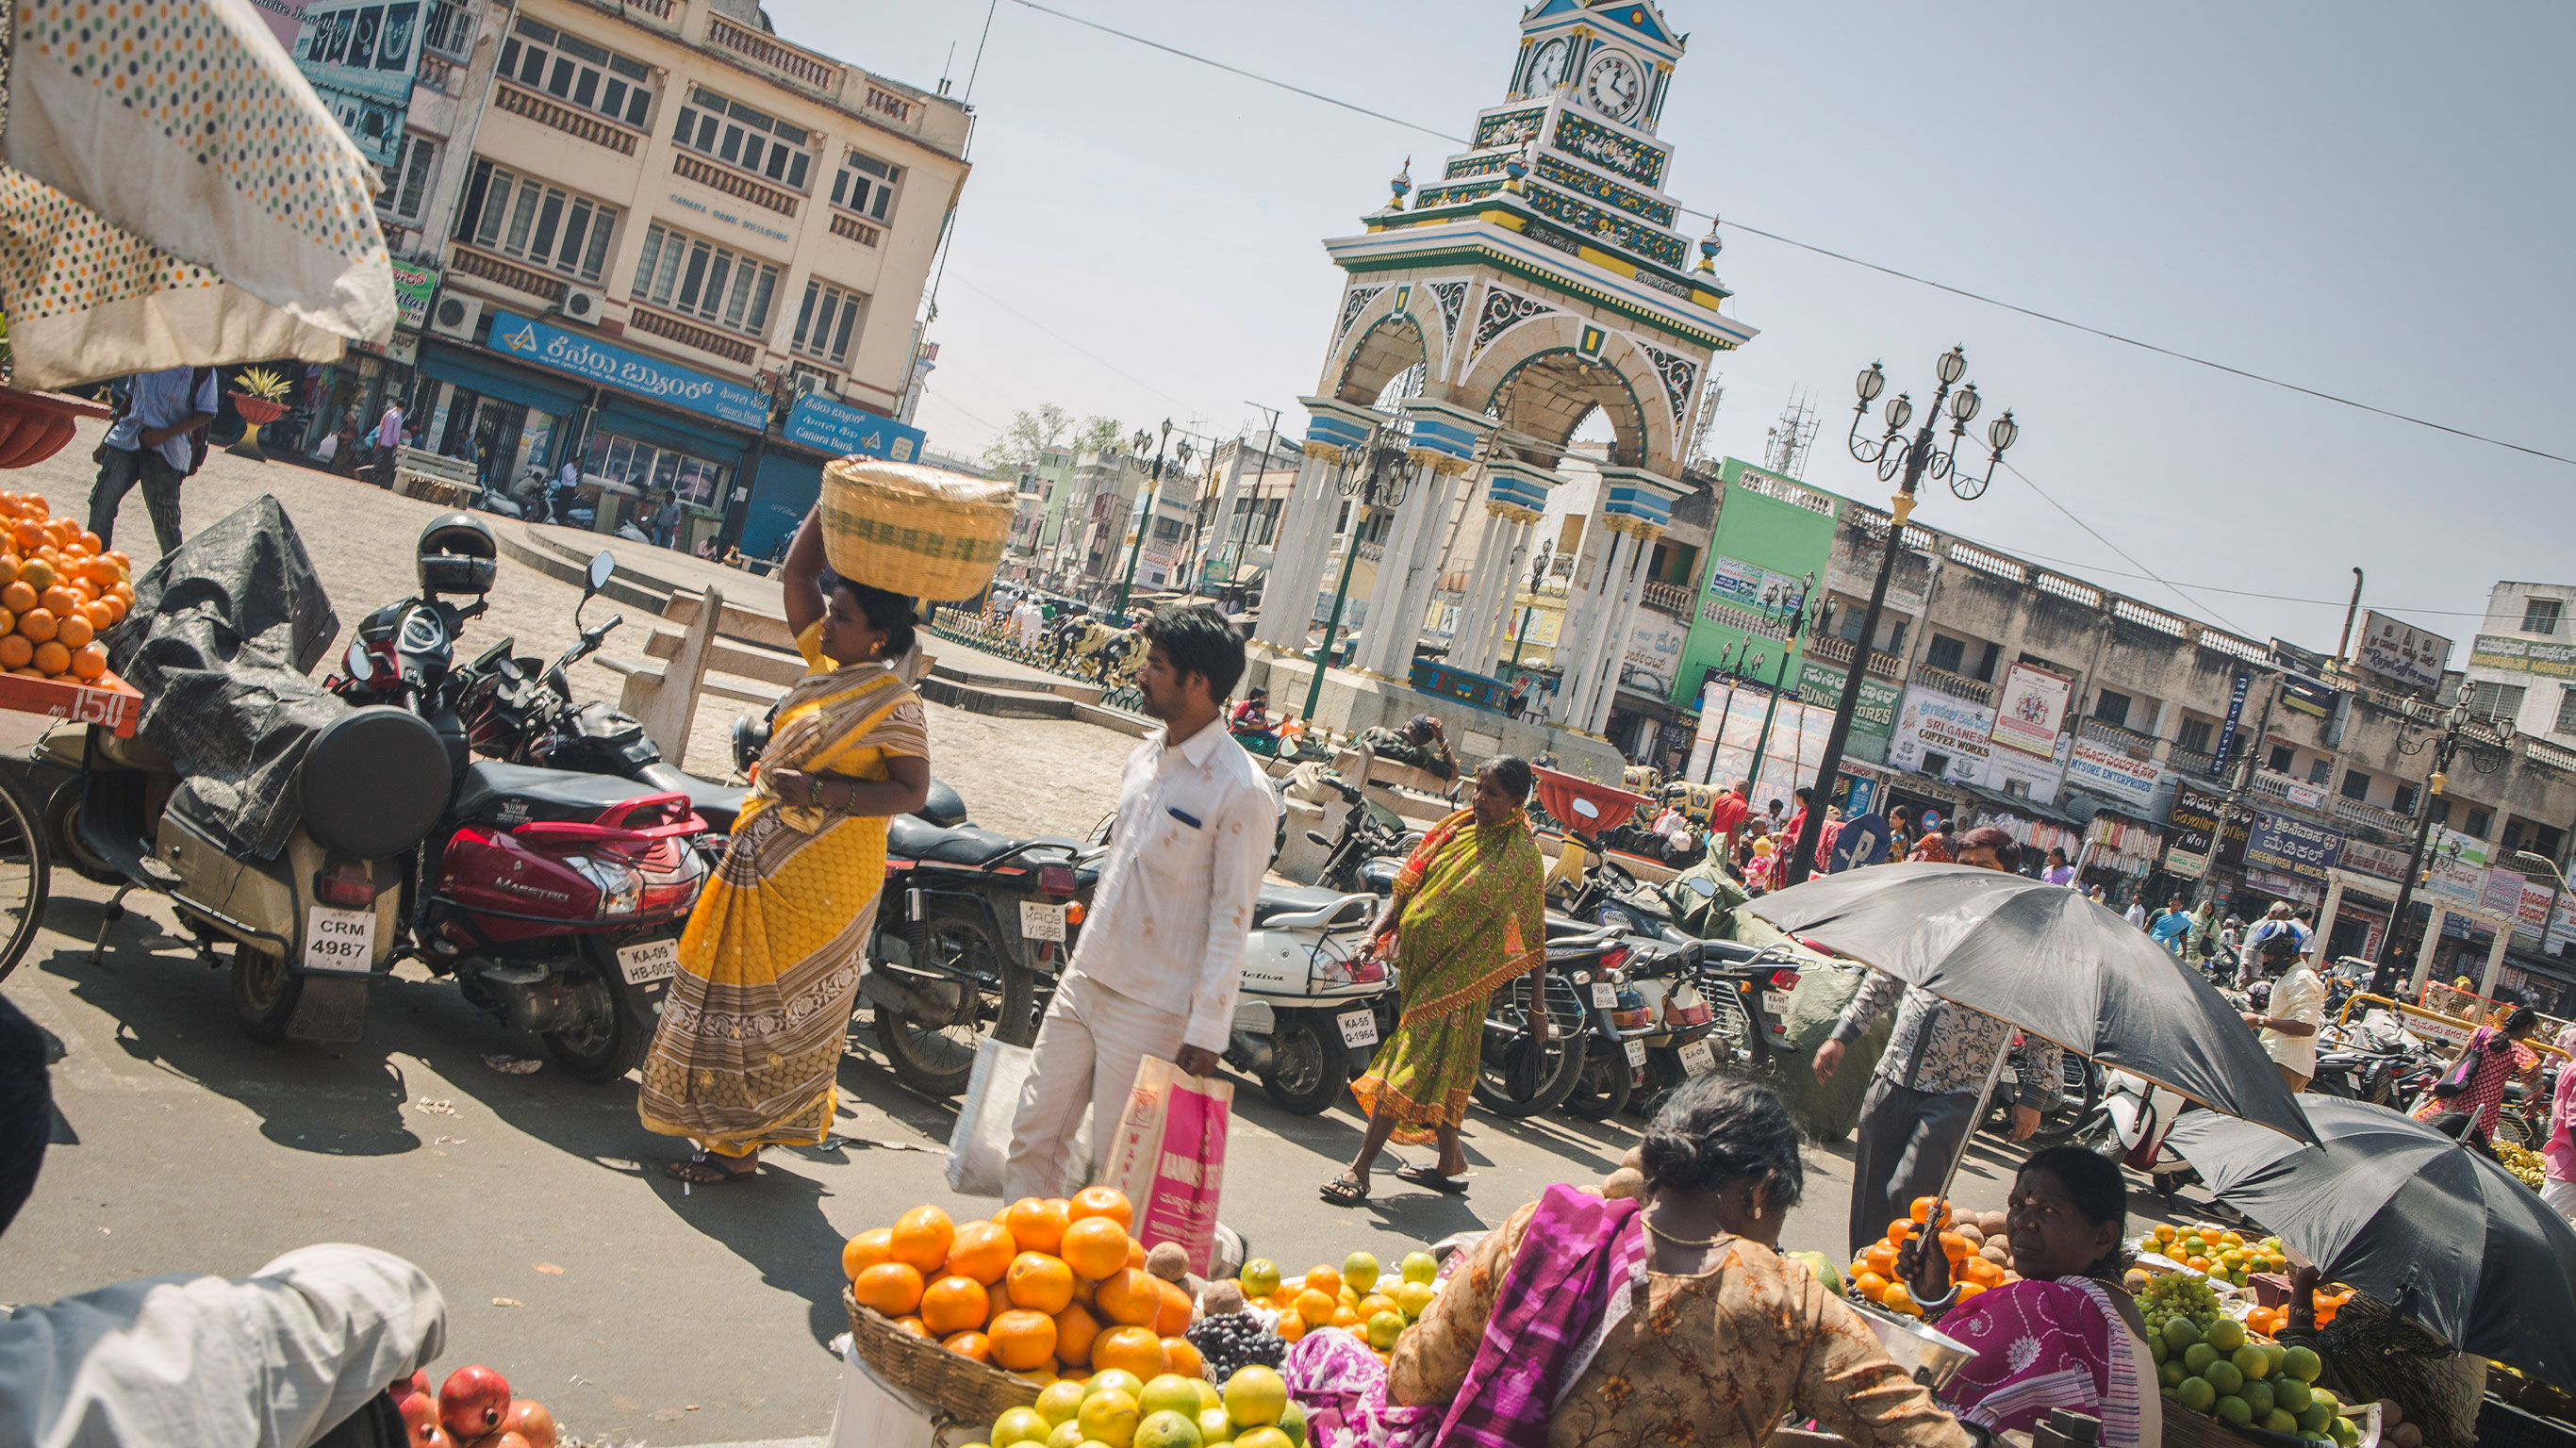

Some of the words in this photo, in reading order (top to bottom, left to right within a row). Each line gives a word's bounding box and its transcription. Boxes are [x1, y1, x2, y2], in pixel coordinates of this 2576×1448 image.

[670, 194, 707, 214] CANARA
[713, 209, 738, 224] BANK
[742, 221, 789, 242] BUILDING
[715, 402, 743, 419] Canara
[743, 408, 763, 425] Bank
[796, 427, 830, 445] Canara
[830, 436, 854, 453] Bank
[2531, 660, 2575, 676] MARKET
[71, 688, 127, 728] 150
[1798, 682, 1837, 710] SUNIL
[1926, 718, 1944, 732] SRI
[1919, 729, 1956, 748] COFFEE
[1957, 739, 1990, 758] WORKS
[2070, 758, 2102, 777] MYSORE
[2102, 767, 2153, 793] ENTERPRISES
[2172, 809, 2218, 833] Gayathri
[1847, 830, 1876, 871] P
[2248, 848, 2292, 870] SREENIVASA
[2293, 862, 2329, 880] MEDICALS
[320, 919, 365, 936] CRM
[310, 940, 366, 959] 4987
[632, 946, 669, 963] KA-09
[1240, 970, 1285, 981] Activa
[1345, 1016, 1370, 1029] KA-55
